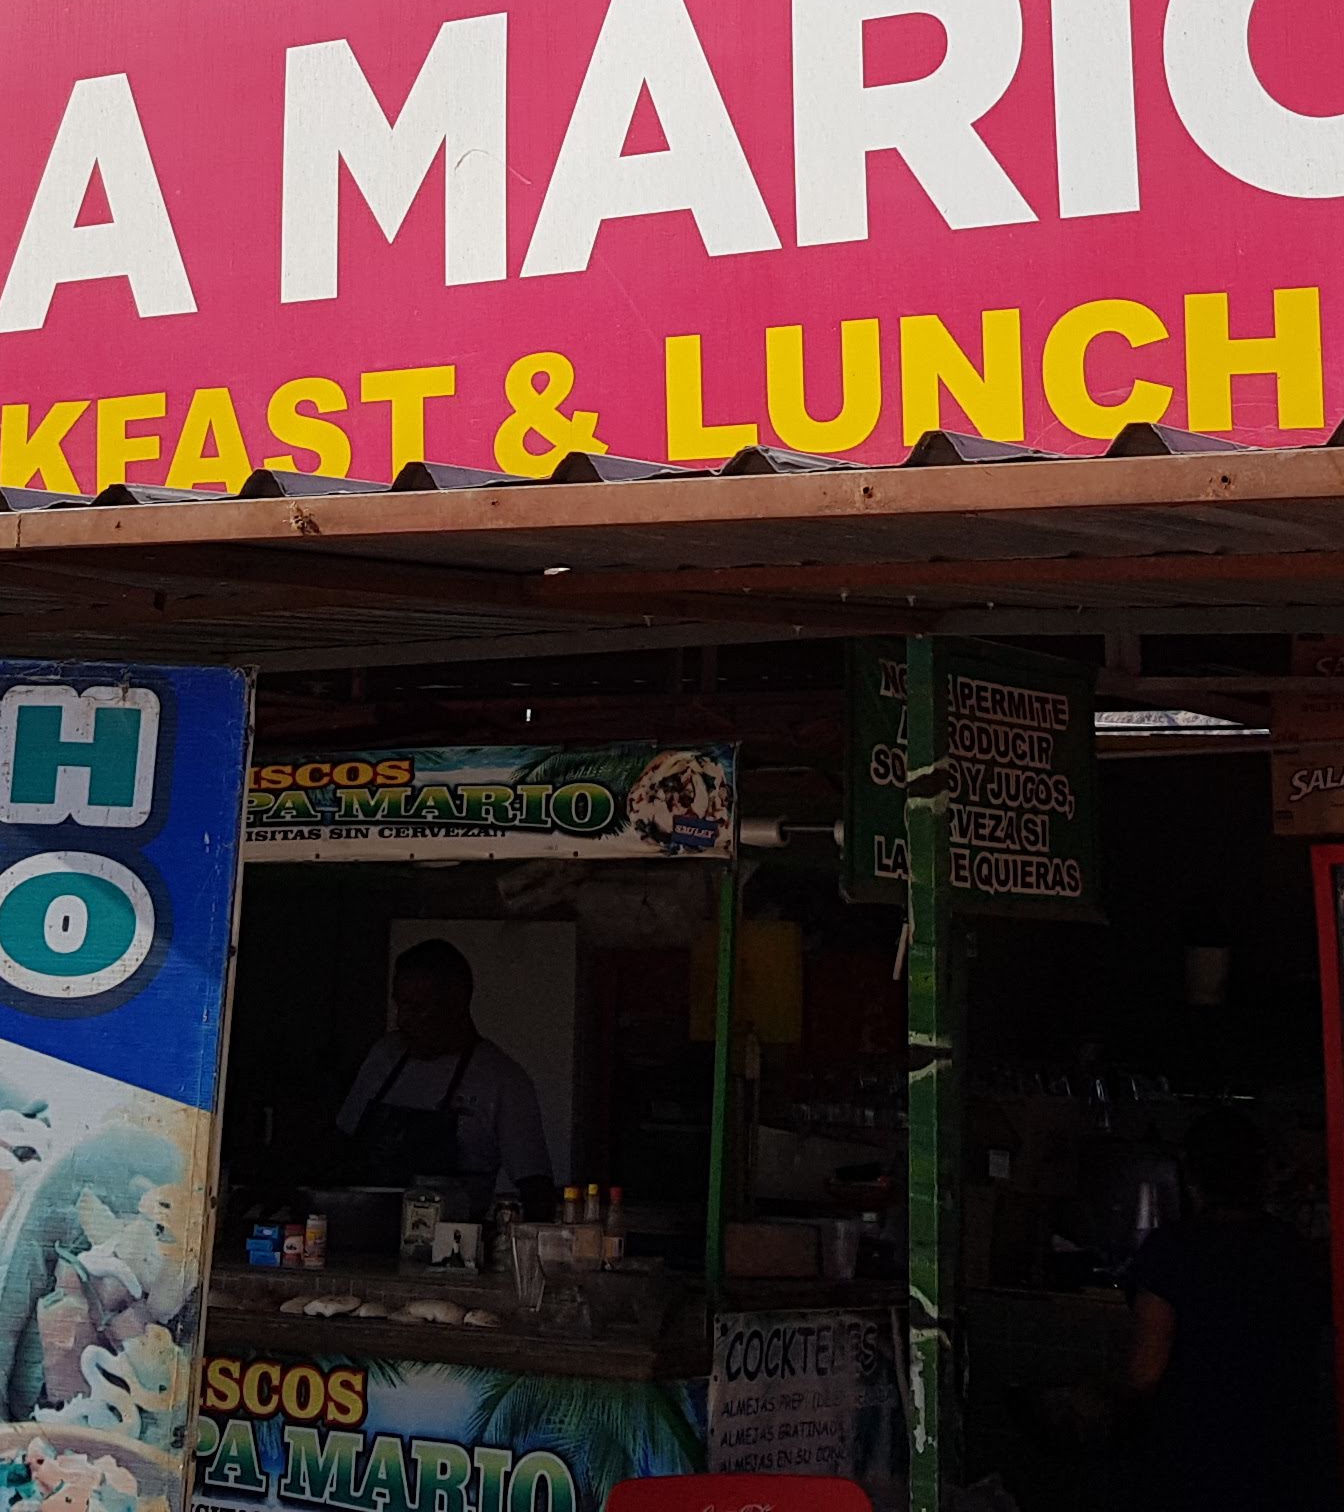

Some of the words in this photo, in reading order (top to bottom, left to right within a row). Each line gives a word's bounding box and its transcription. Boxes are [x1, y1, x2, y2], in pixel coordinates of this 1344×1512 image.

[493, 351, 609, 478] &
[665, 287, 1326, 461] LUNCH
[957, 675, 1070, 731] PERMITE
[335, 782, 615, 831] MARIO
[964, 762, 986, 803] Y
[328, 826, 370, 840] SIN
[1021, 813, 1050, 853] SI
[874, 835, 908, 880] LA
[973, 850, 1082, 897] QUIERAS
[201, 1356, 364, 1426] SCOS
